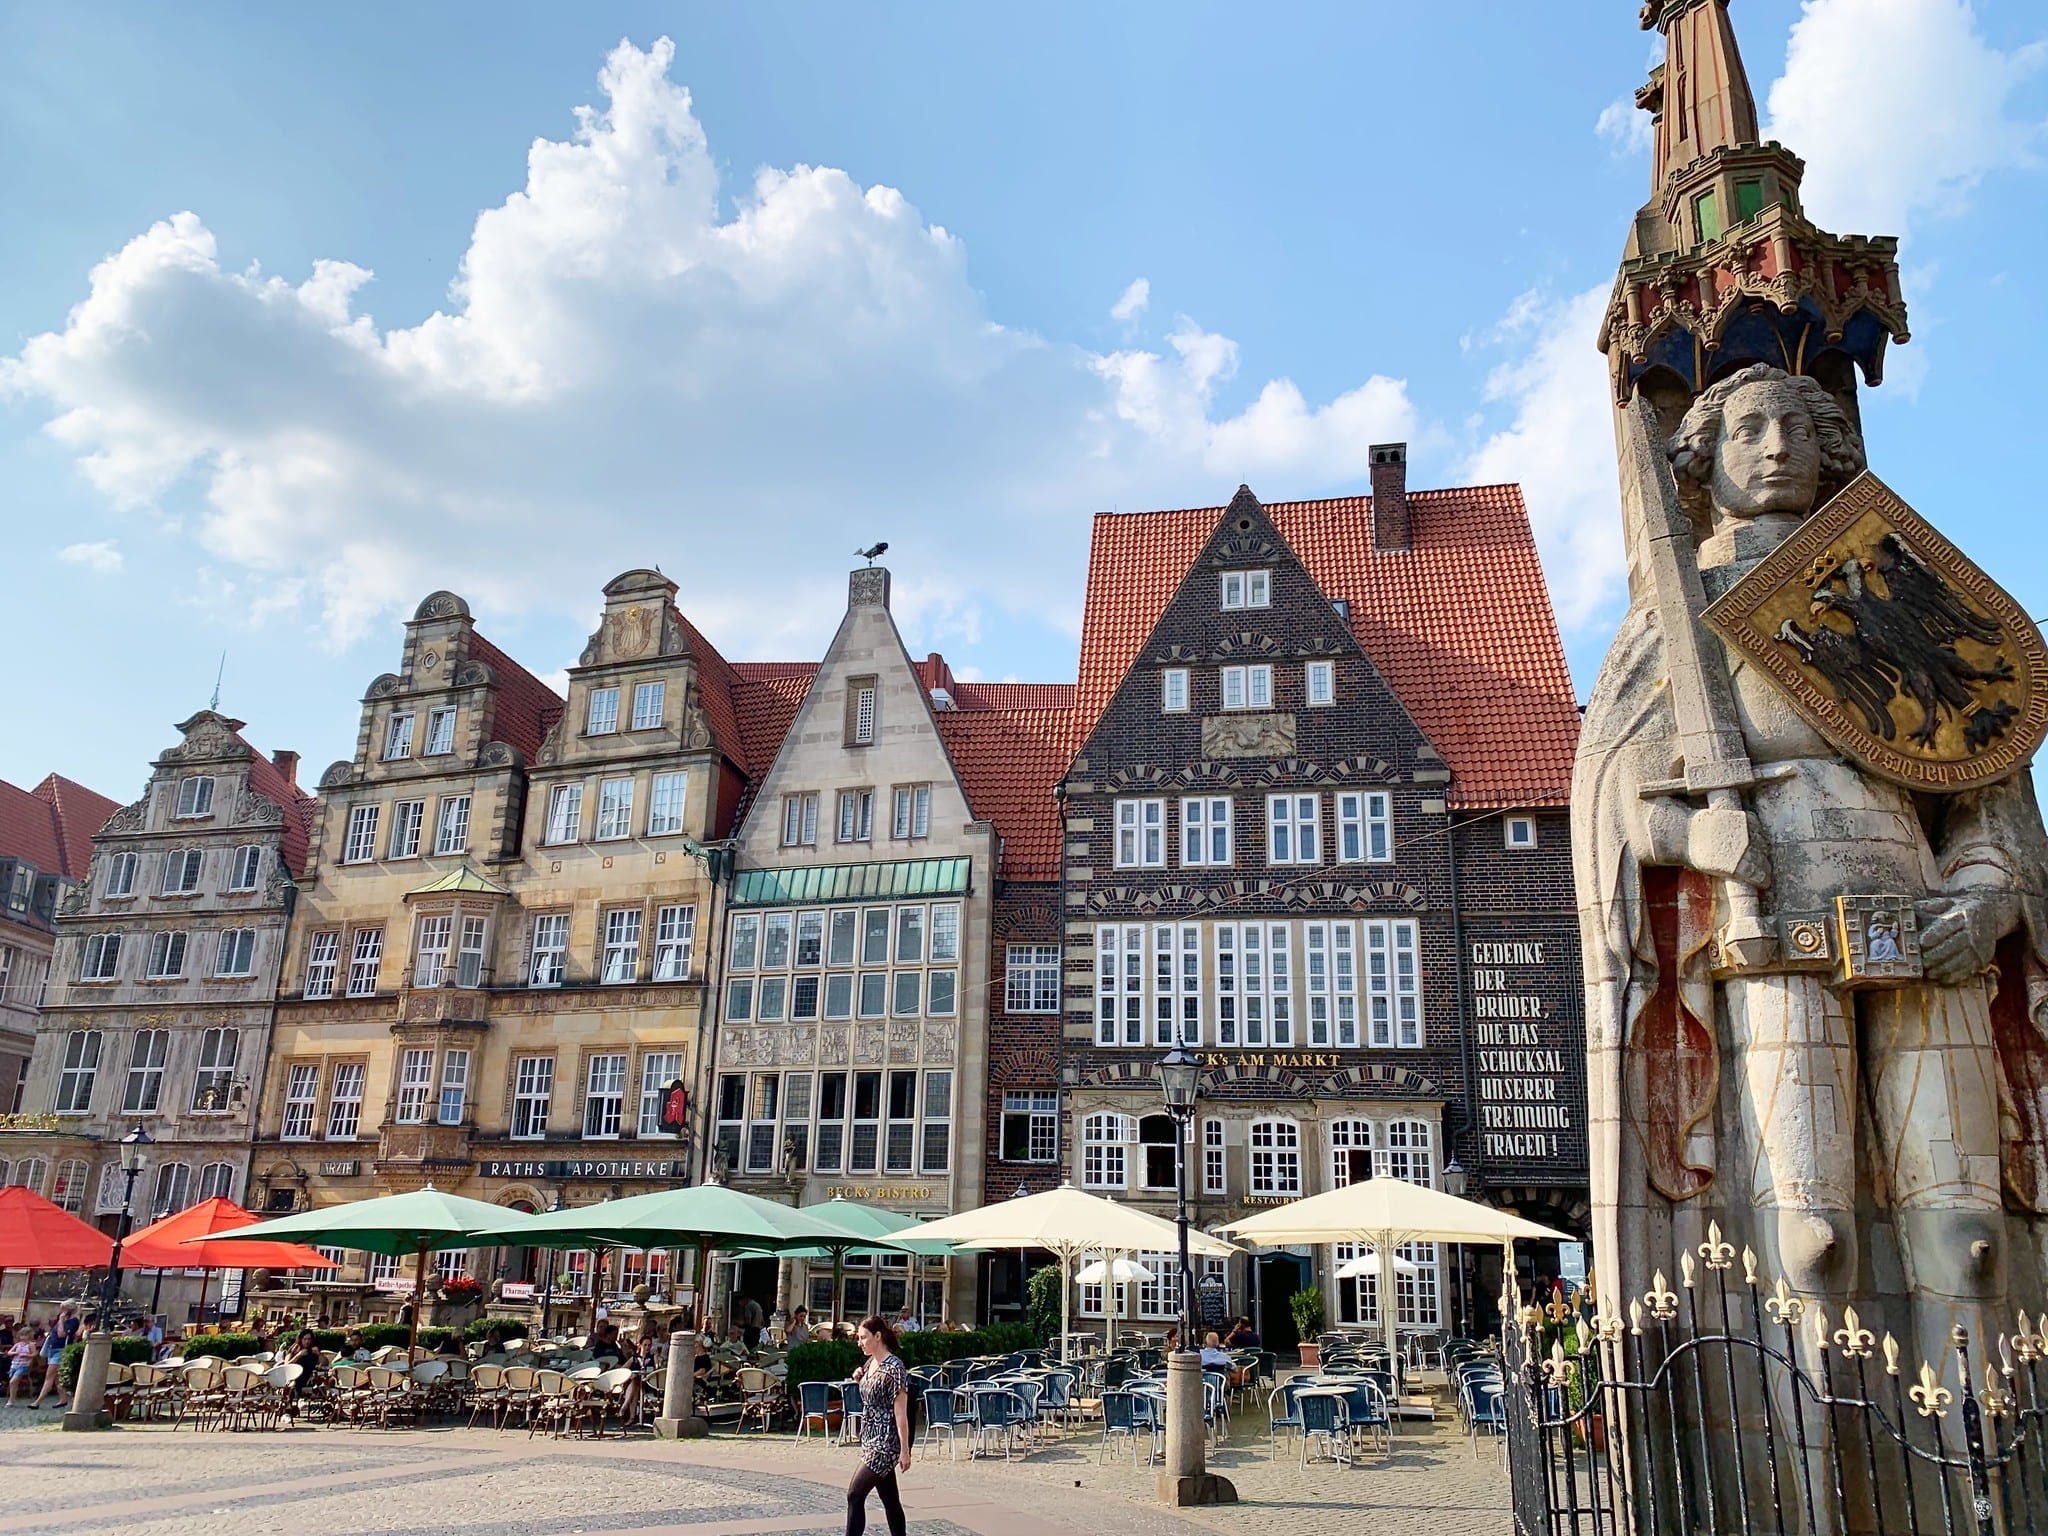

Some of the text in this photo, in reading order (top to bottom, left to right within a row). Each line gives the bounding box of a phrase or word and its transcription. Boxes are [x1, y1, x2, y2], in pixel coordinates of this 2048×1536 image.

[1473, 943, 1544, 964] GEDENKE
[1474, 970, 1505, 990] DER
[1476, 993, 1549, 1019] BRÜDER,
[1478, 1024, 1538, 1045] DIE DAS
[1195, 1054, 1340, 1066] CK's AM MARKT
[1480, 1051, 1564, 1072] SCHICKSAL
[1481, 1078, 1555, 1100] UNSERER
[1483, 1106, 1569, 1128] TRENNUNG
[491, 1162, 668, 1176] RATHS APOTHEKE
[878, 1187, 930, 1198] BISTRO
